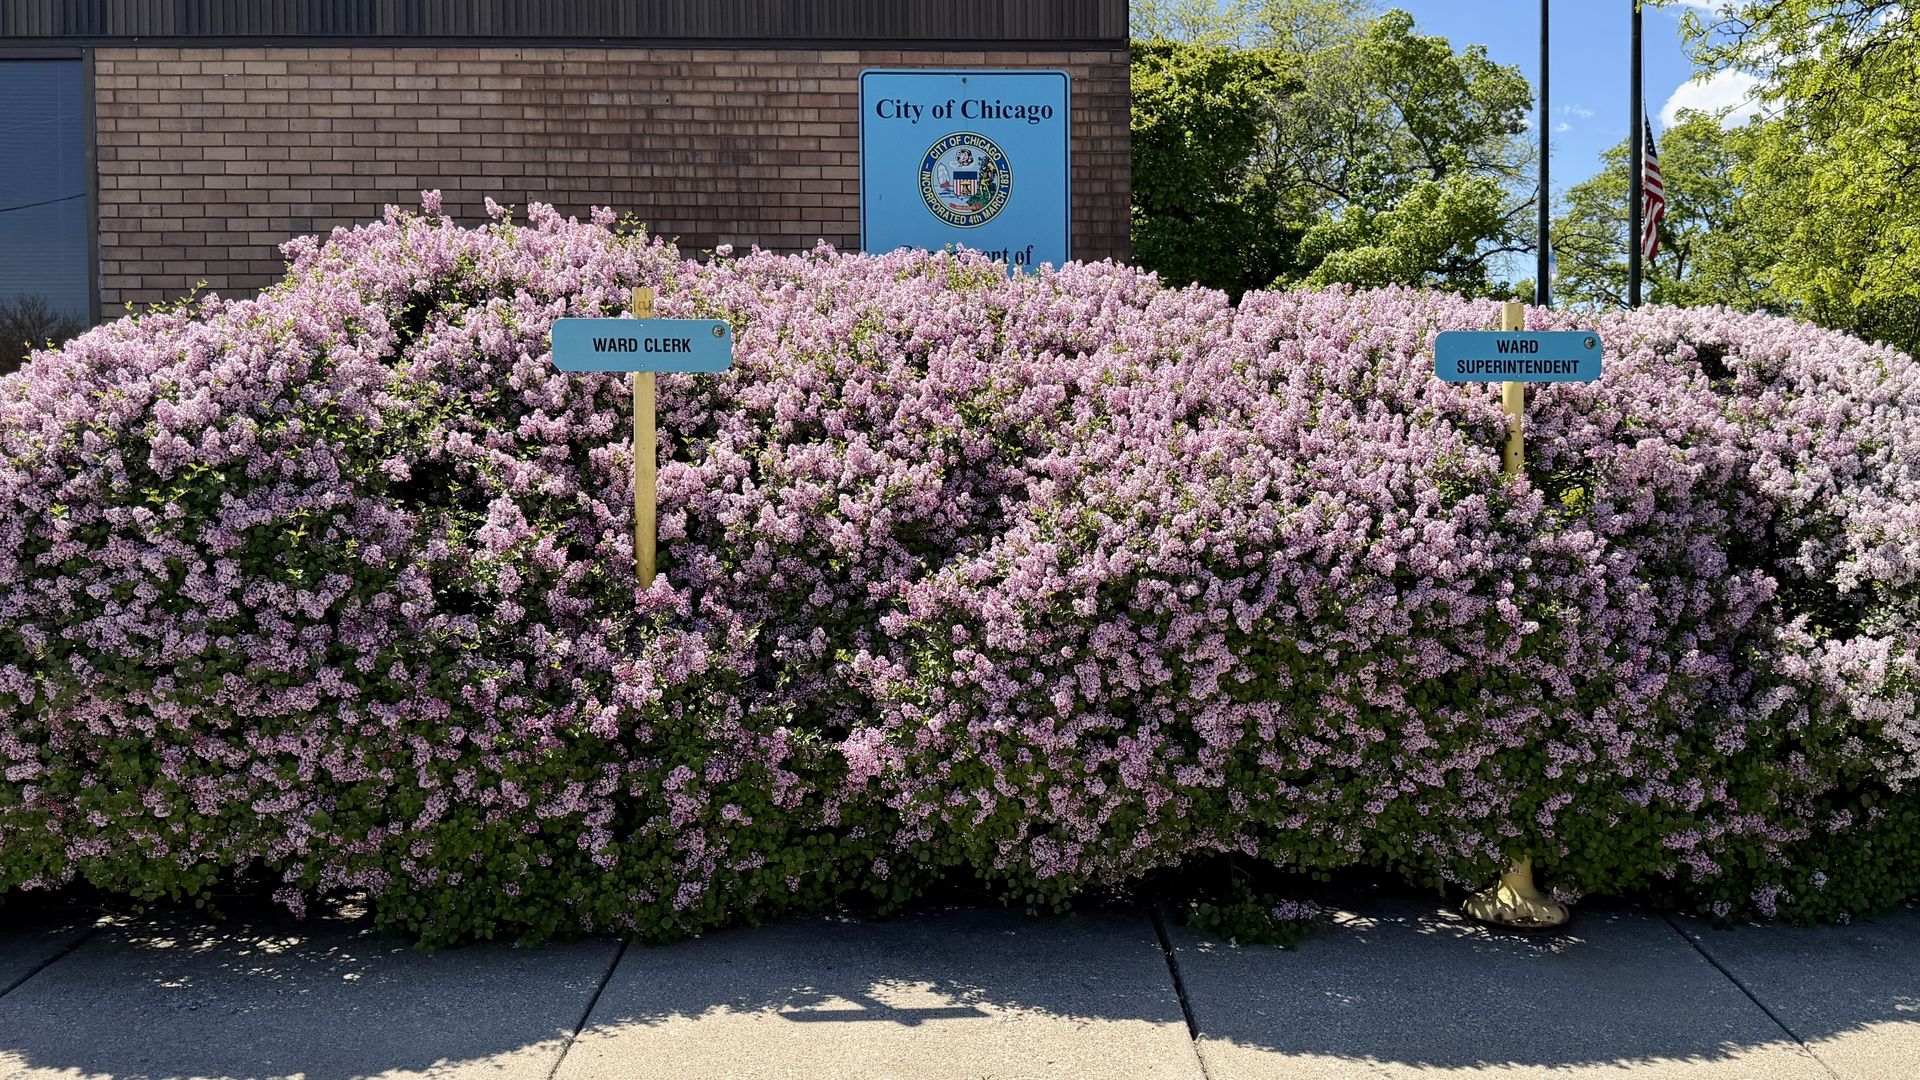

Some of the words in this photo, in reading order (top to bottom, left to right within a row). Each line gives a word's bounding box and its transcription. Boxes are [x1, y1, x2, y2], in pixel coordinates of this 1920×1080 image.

[876, 98, 924, 124] City
[931, 99, 956, 119] of
[960, 99, 1053, 125] Chicago
[930, 141, 948, 160] CITY
[949, 136, 962, 147] OF
[963, 135, 1001, 161] CHICAGO
[921, 170, 966, 224] INCORPORATED
[968, 214, 983, 225] 4th
[982, 190, 1007, 219] MARCH
[999, 169, 1010, 188] 1837
[1015, 245, 1034, 265] of
[593, 338, 638, 353] WARD
[644, 338, 692, 353] CLERK
[1496, 339, 1539, 354] WARD
[1457, 359, 1580, 374] SUPERINTENDENT
